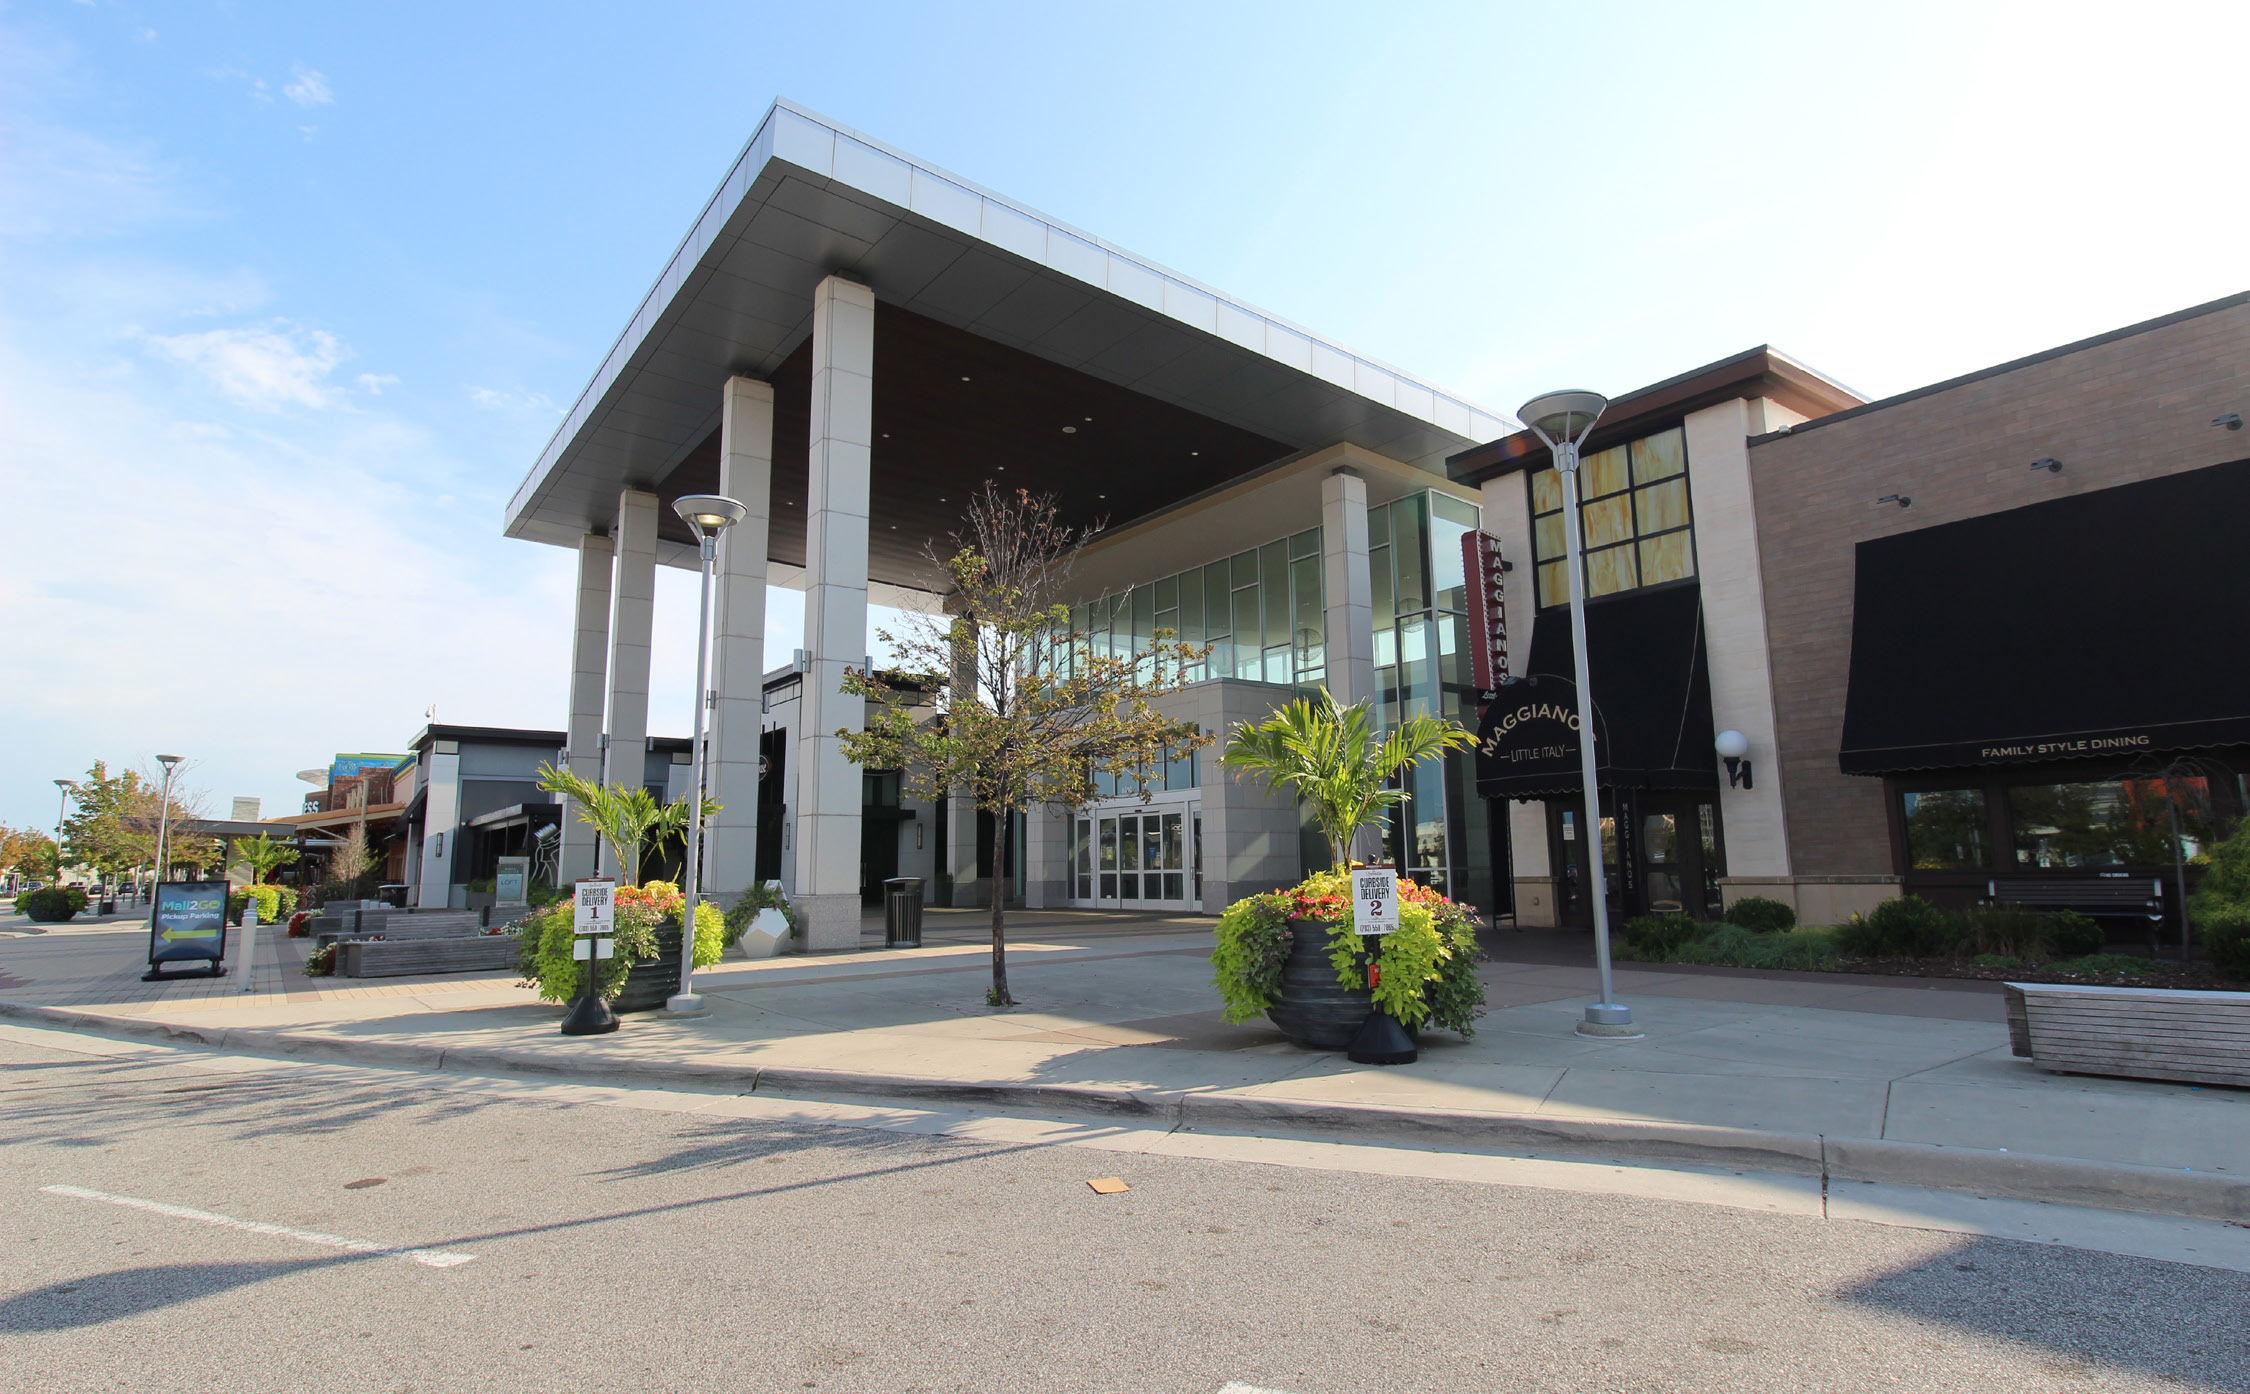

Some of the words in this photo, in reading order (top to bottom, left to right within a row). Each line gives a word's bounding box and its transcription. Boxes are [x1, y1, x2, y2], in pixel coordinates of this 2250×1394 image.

[1982, 746, 2035, 757] FAMILY
[2038, 741, 2088, 753] STYLE
[2091, 736, 2150, 749] DINING
[1511, 749, 1540, 762] LITTLE
[1541, 744, 1565, 758] ITALY
[1622, 803, 1634, 889] MAGGIANOS
[1360, 877, 1389, 888] CURBSIDE
[582, 888, 608, 897] CURBSIDE
[1361, 888, 1390, 900] DELIVERY
[162, 900, 221, 911] Mall2GO
[582, 896, 608, 906] DELIVERY
[590, 906, 599, 918] 1
[1370, 900, 1382, 916] 2
[189, 912, 220, 920] Parking
